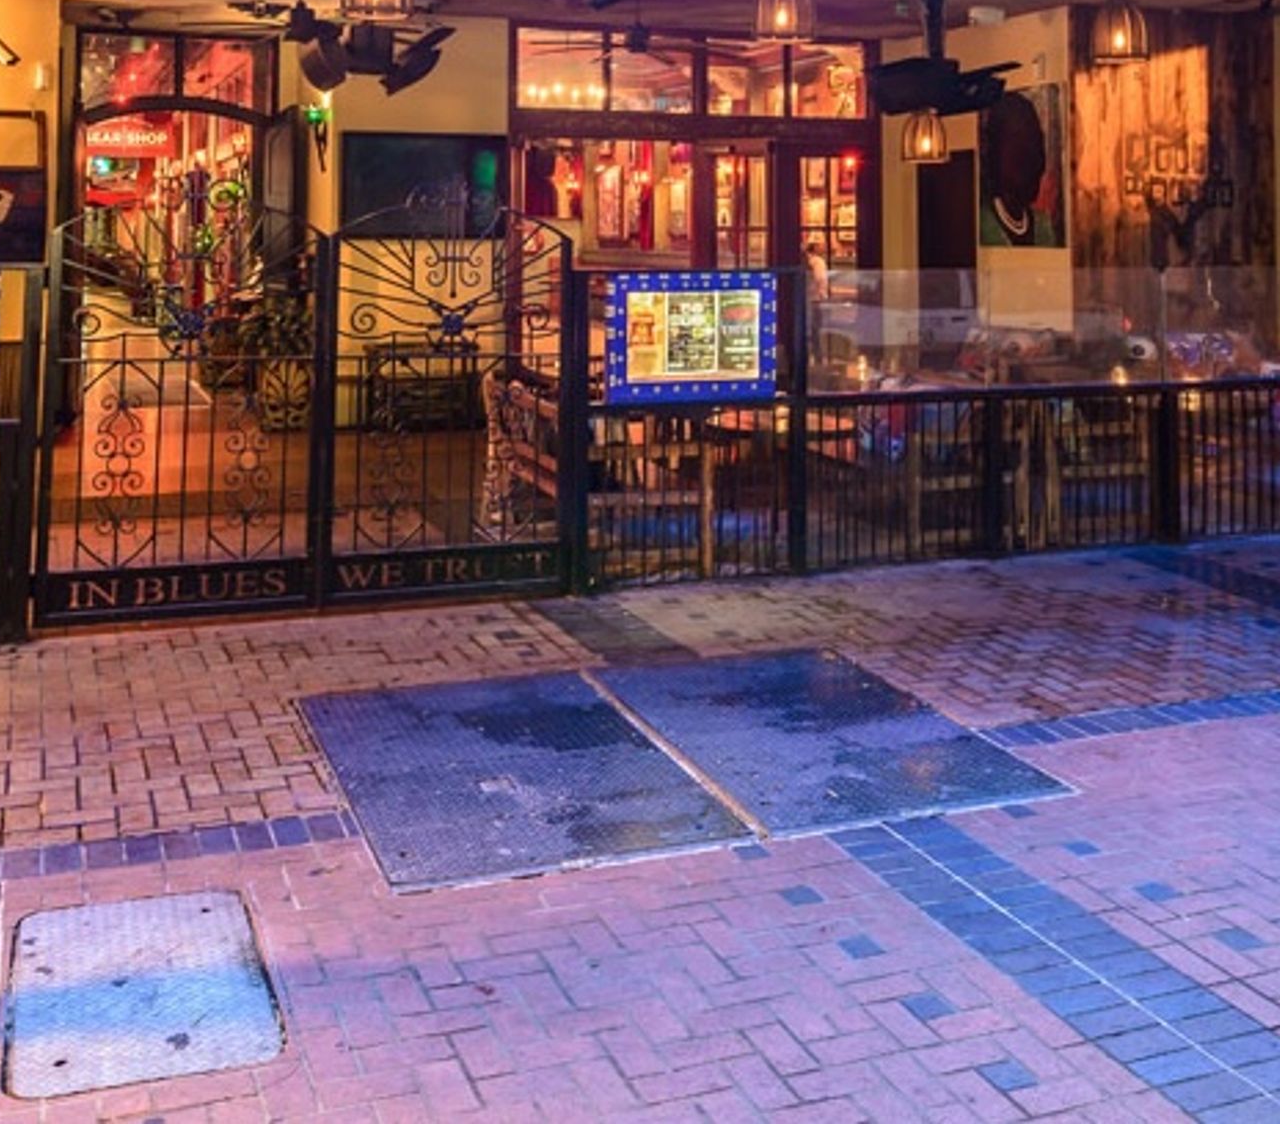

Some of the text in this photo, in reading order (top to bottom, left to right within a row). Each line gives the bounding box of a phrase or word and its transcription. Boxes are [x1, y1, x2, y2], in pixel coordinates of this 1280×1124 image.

[127, 130, 168, 145] SHOP
[69, 578, 118, 609] IN
[134, 567, 287, 606] BLUES
[338, 561, 405, 590] WE
